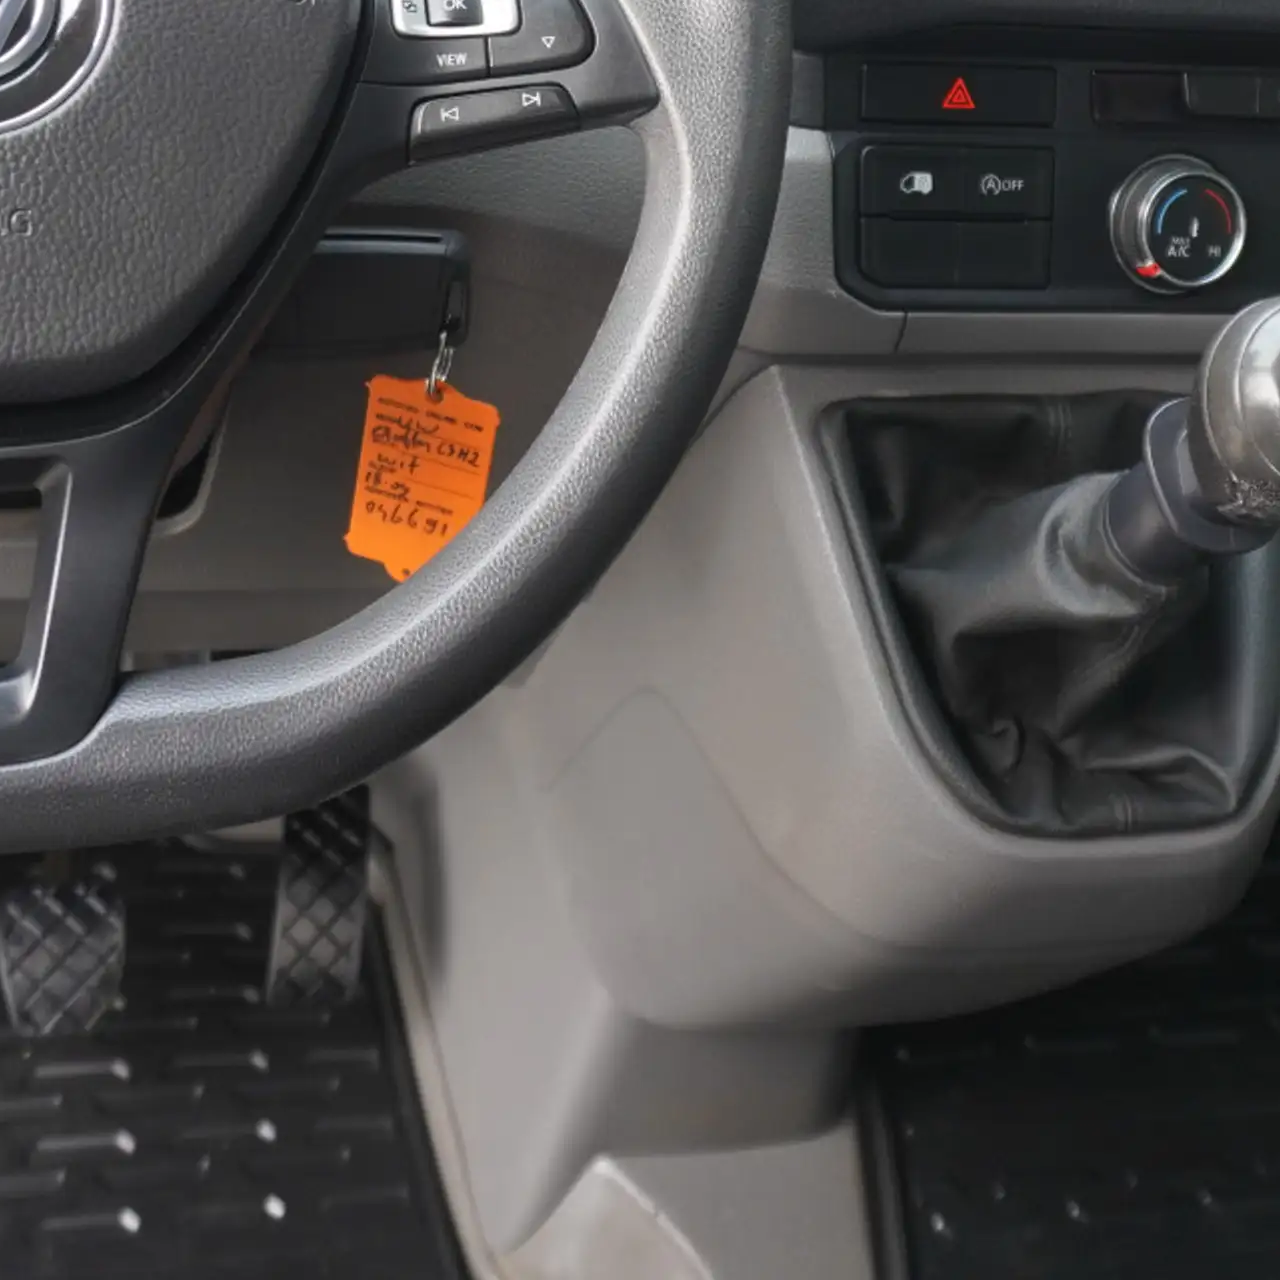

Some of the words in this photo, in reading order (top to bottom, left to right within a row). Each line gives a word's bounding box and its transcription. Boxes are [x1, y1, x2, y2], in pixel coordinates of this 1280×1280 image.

[436, 53, 468, 66] VIEW
[1001, 179, 1024, 191] OFF
[1167, 245, 1190, 258] A/C
